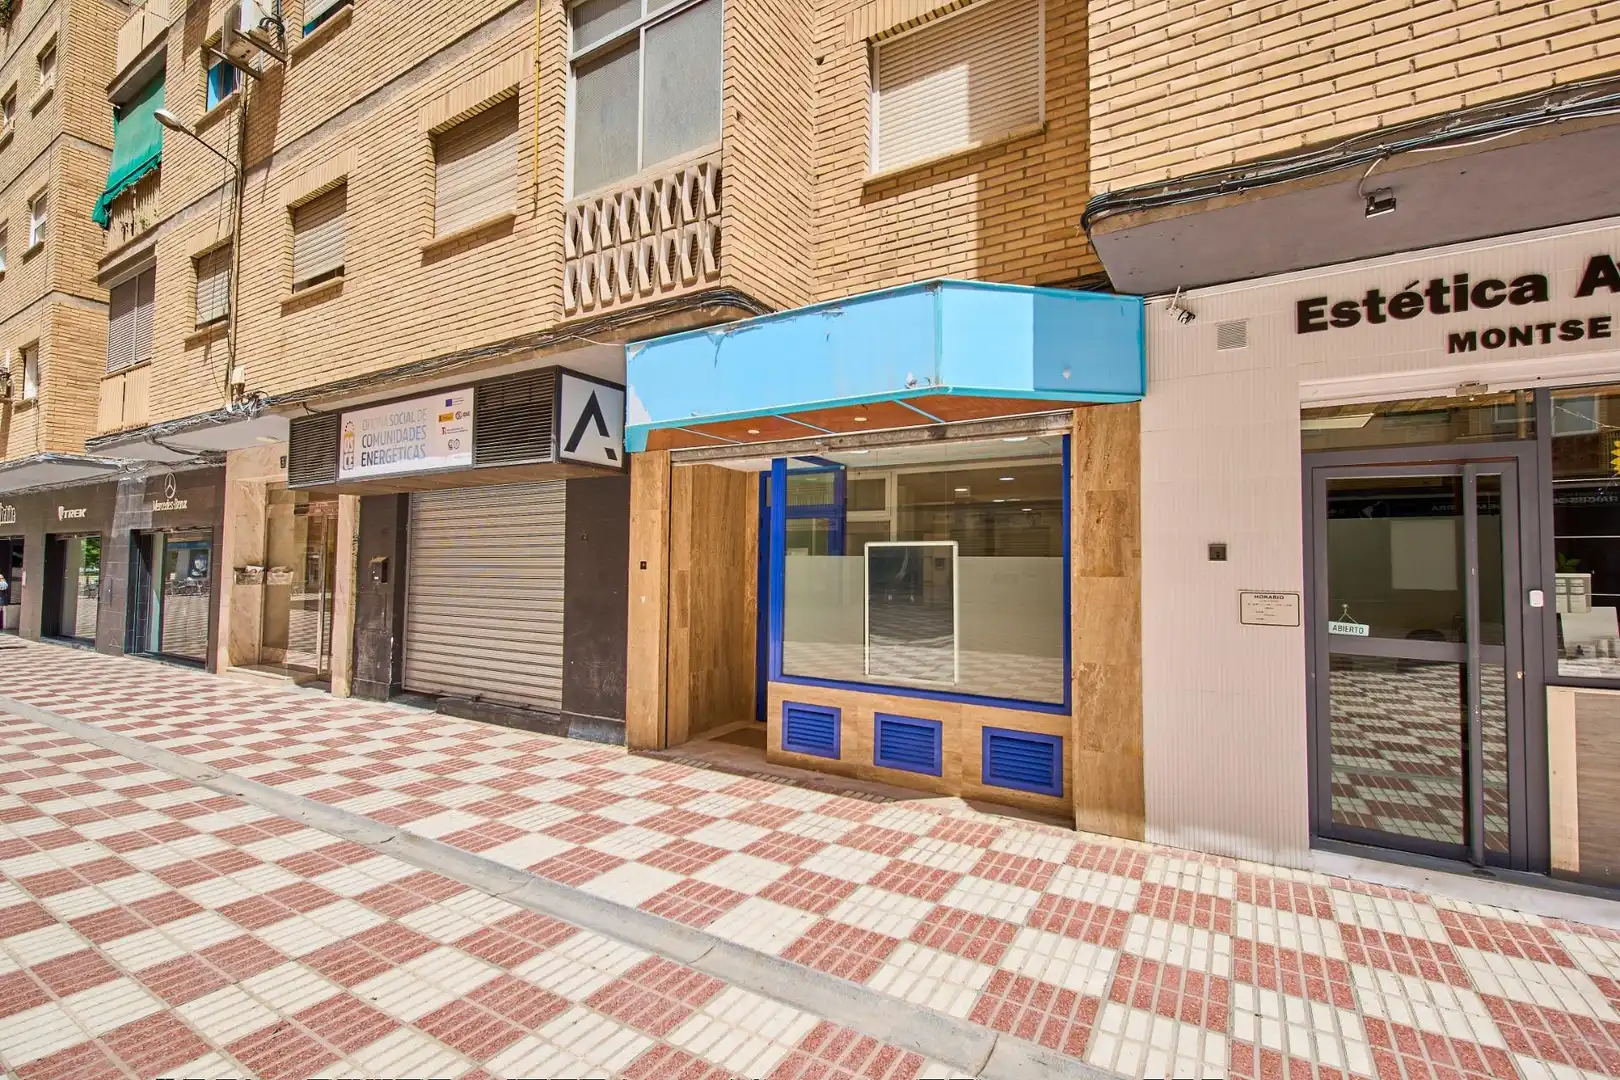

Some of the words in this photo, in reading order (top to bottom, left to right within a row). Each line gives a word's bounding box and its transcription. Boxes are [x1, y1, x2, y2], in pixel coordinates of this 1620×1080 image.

[1296, 272, 1549, 334] Estética
[1574, 254, 1620, 299] A
[1448, 315, 1612, 354] MONTSE
[389, 411, 416, 427] SOCIAL
[417, 407, 428, 422] DE
[361, 425, 427, 449] COMUNIDADES
[63, 508, 87, 519] TREK
[1332, 624, 1364, 635] ABIERTO
